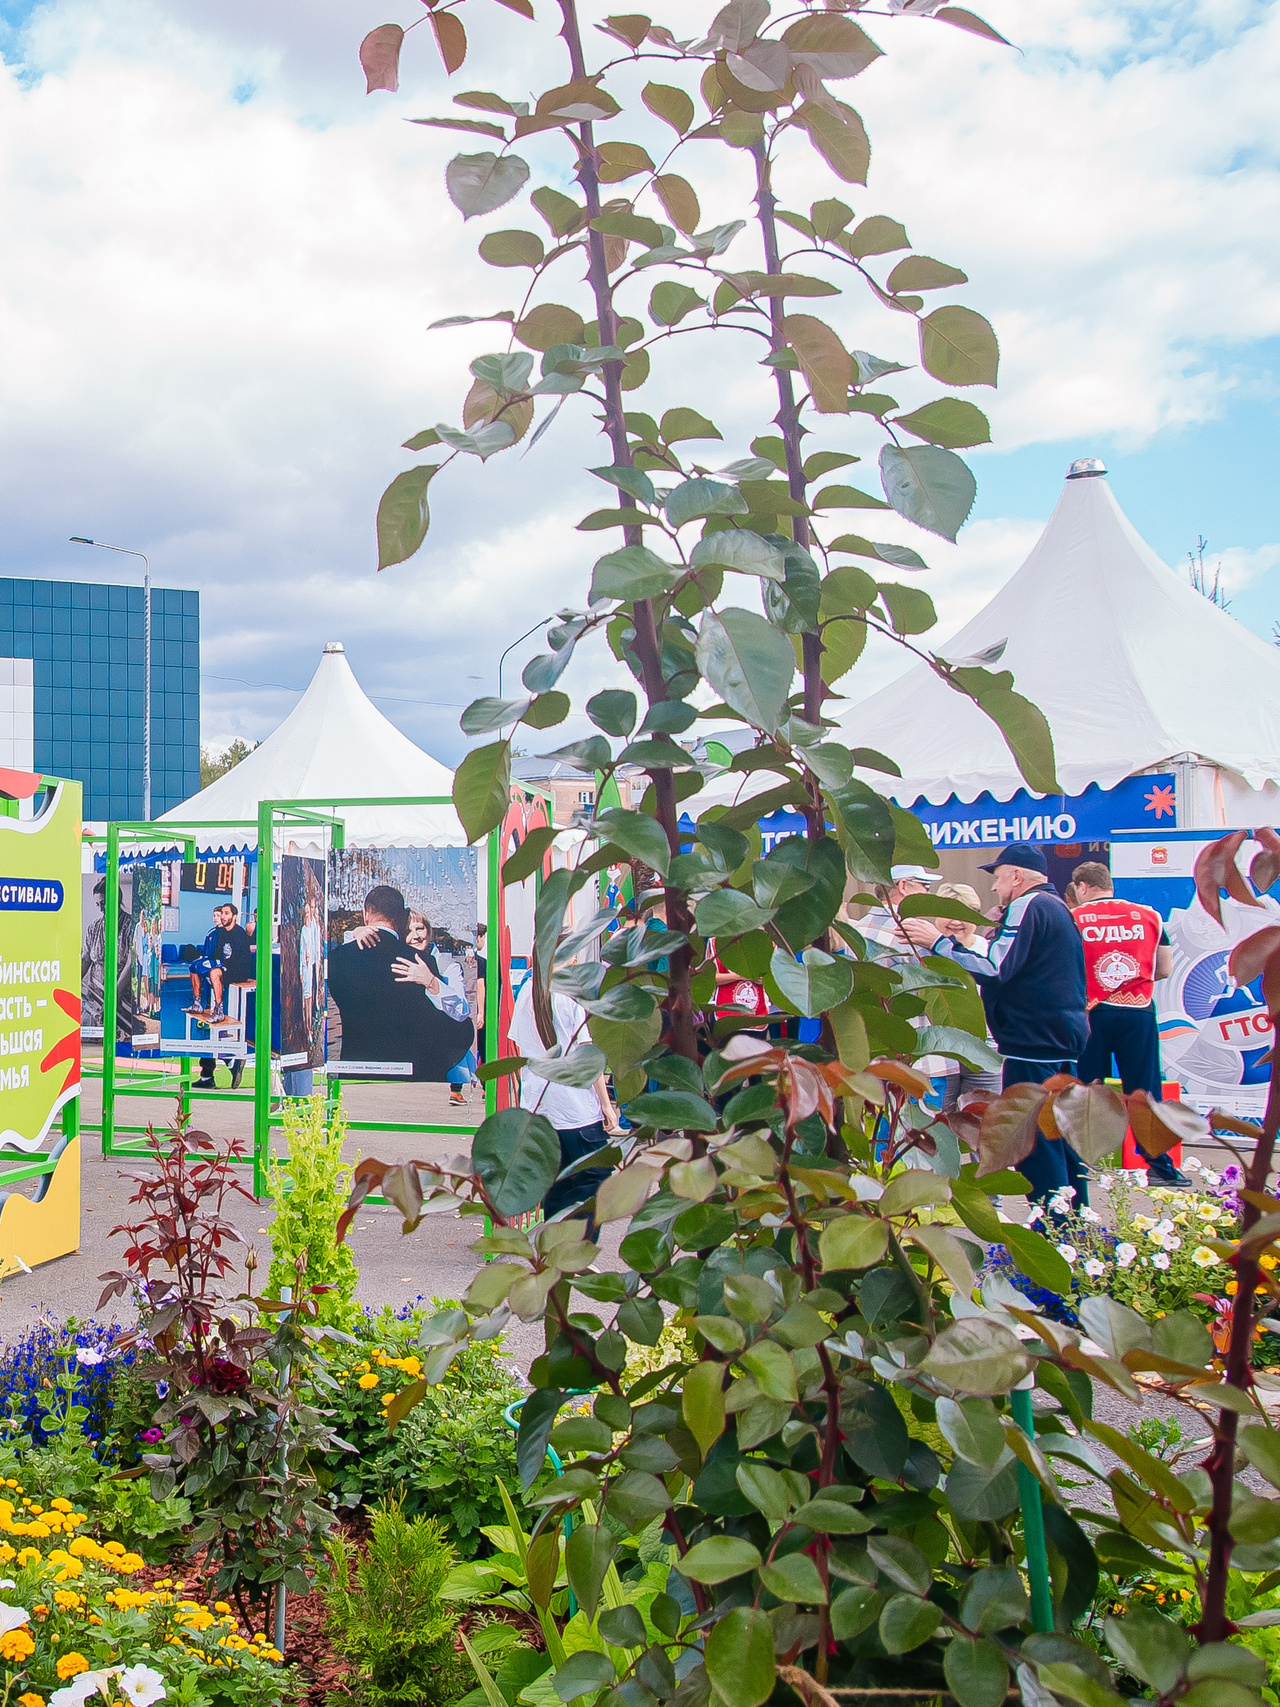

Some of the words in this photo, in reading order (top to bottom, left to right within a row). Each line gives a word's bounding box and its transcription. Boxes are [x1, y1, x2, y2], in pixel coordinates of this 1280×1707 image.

[923, 813, 1077, 845] ИЖЕНИЮ
[1082, 924, 1145, 944] СУДЬЯ
[1219, 1013, 1273, 1041] ГТО
